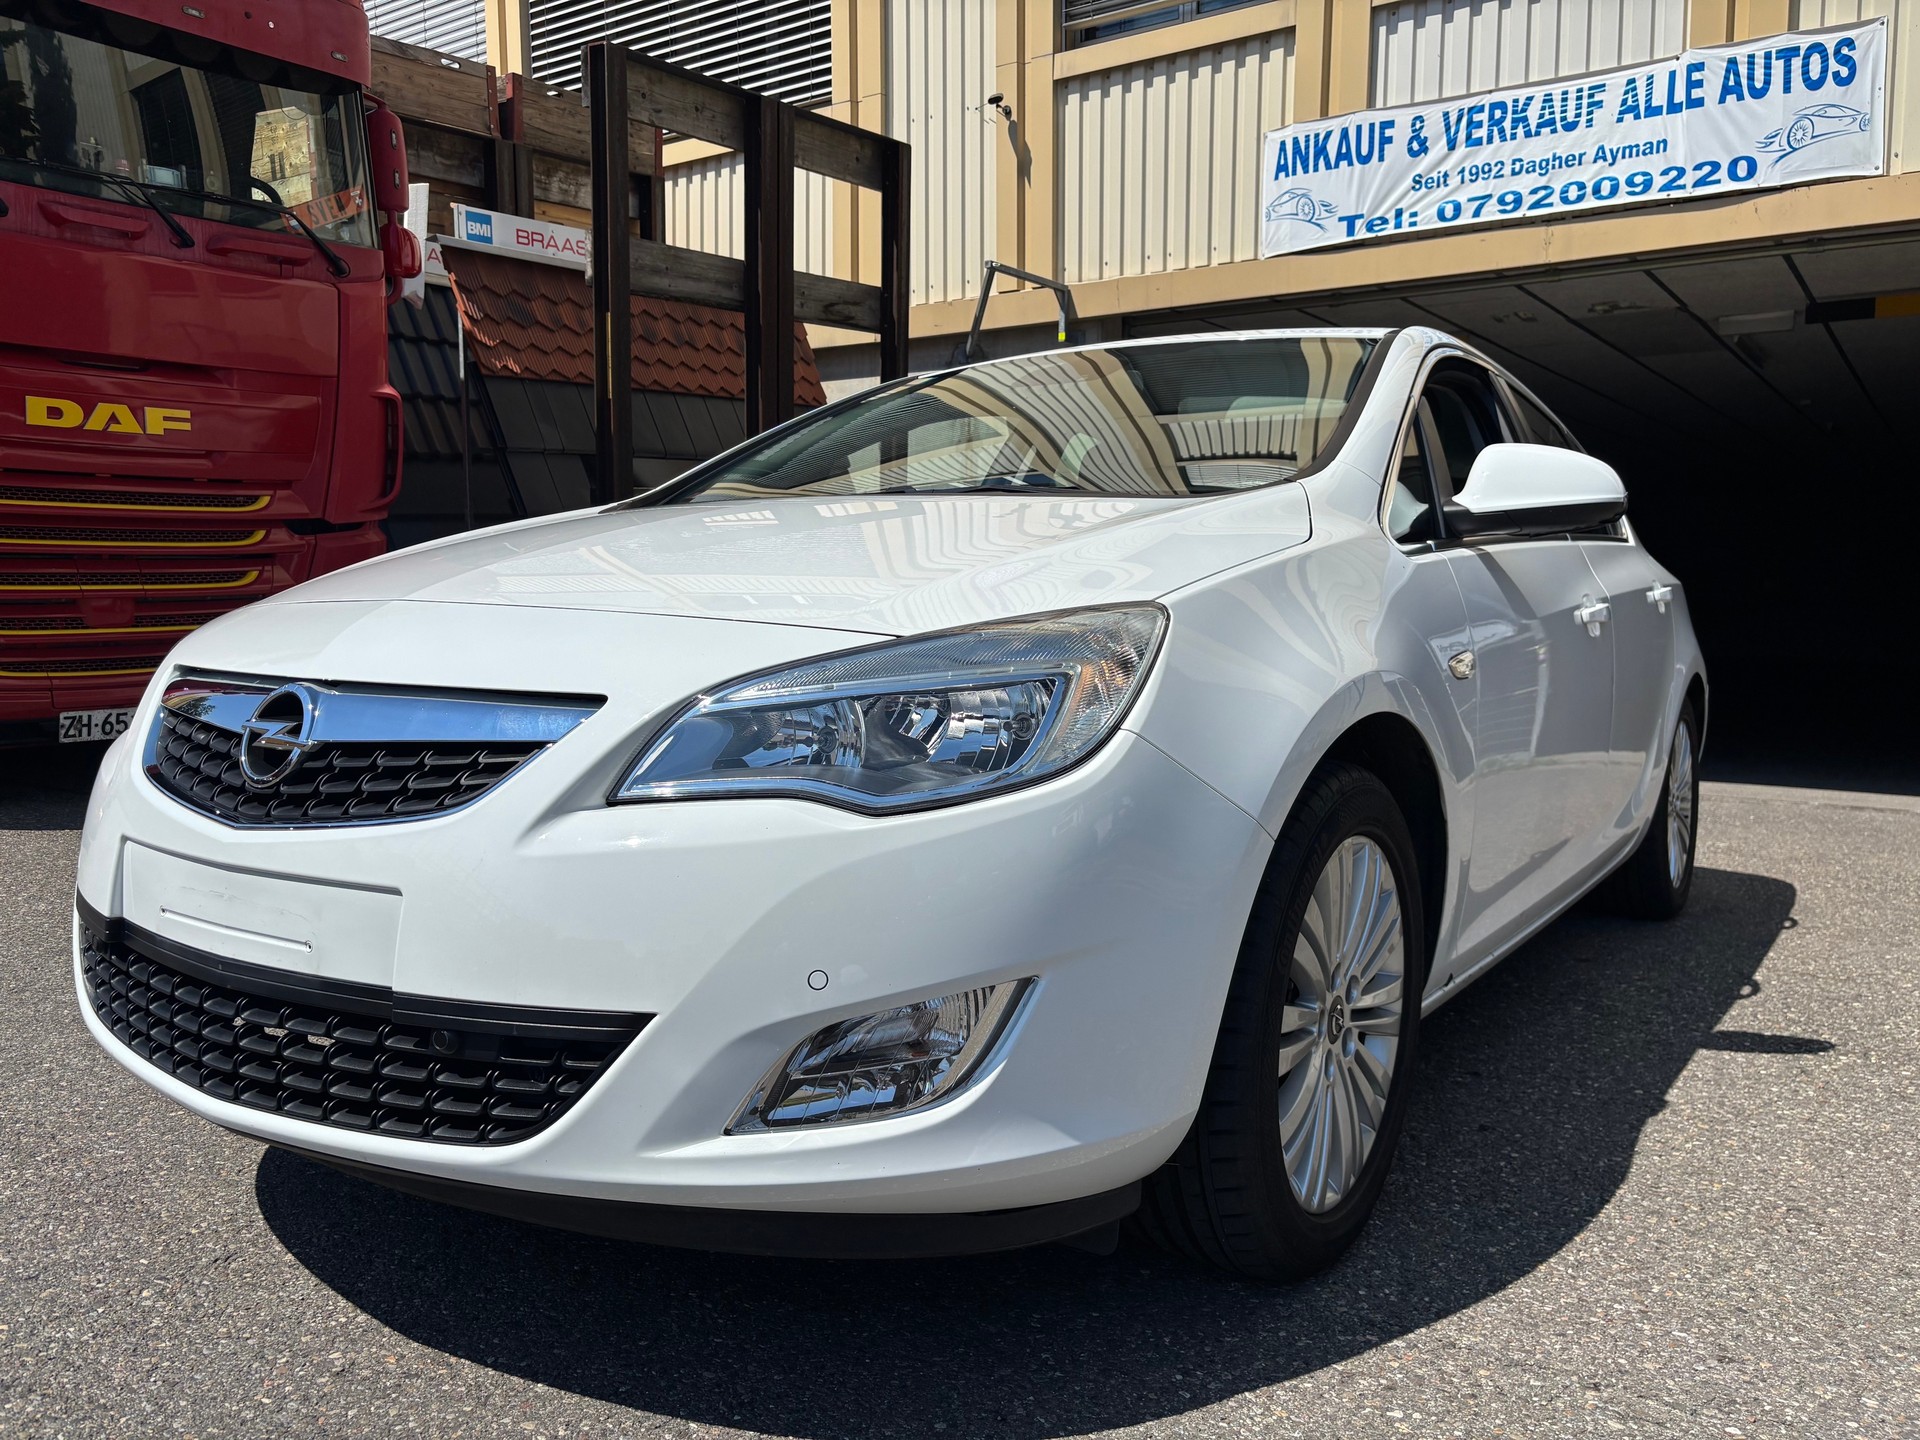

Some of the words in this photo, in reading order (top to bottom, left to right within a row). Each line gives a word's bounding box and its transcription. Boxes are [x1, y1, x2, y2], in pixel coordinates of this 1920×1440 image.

[1274, 119, 1396, 181] ANKAUF
[1406, 115, 1430, 158] &
[1442, 82, 1607, 152] VERKAUF
[1615, 61, 1705, 123] ALLE
[1717, 36, 1857, 105] AUTOS
[1411, 169, 1450, 192] Seit
[1456, 160, 1505, 185] 1992
[1510, 151, 1587, 178] Dagher
[1592, 137, 1668, 167] Ayman
[1337, 207, 1418, 238] Tel:
[1436, 155, 1758, 224] 0792009220
[466, 223, 492, 238] BMI
[25, 395, 192, 435] DAF
